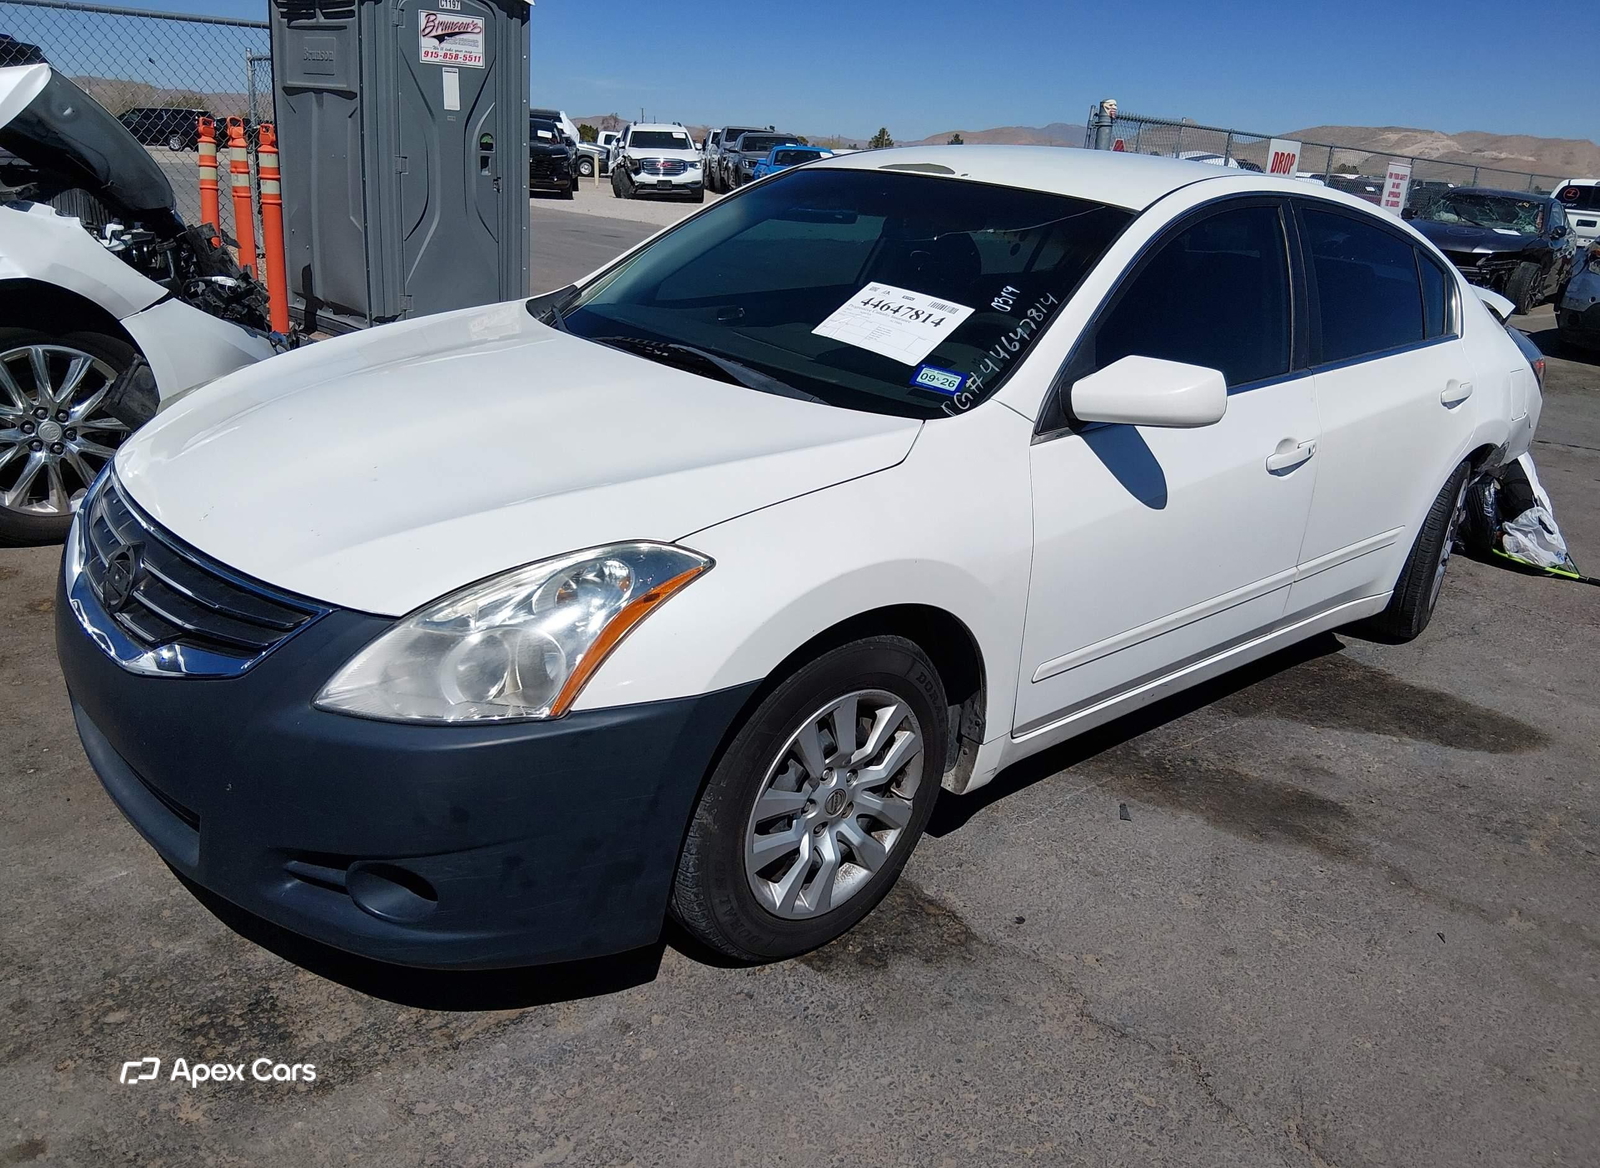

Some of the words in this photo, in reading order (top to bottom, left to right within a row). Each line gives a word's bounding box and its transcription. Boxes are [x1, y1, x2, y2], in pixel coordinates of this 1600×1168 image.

[422, 13, 482, 37] Brunson's
[423, 50, 482, 63] 915-858-5511
[1270, 152, 1296, 175] DROP
[990, 286, 1020, 312] 0319
[860, 297, 946, 328] 44647814
[920, 372, 936, 382] 09
[940, 378, 956, 388] 26
